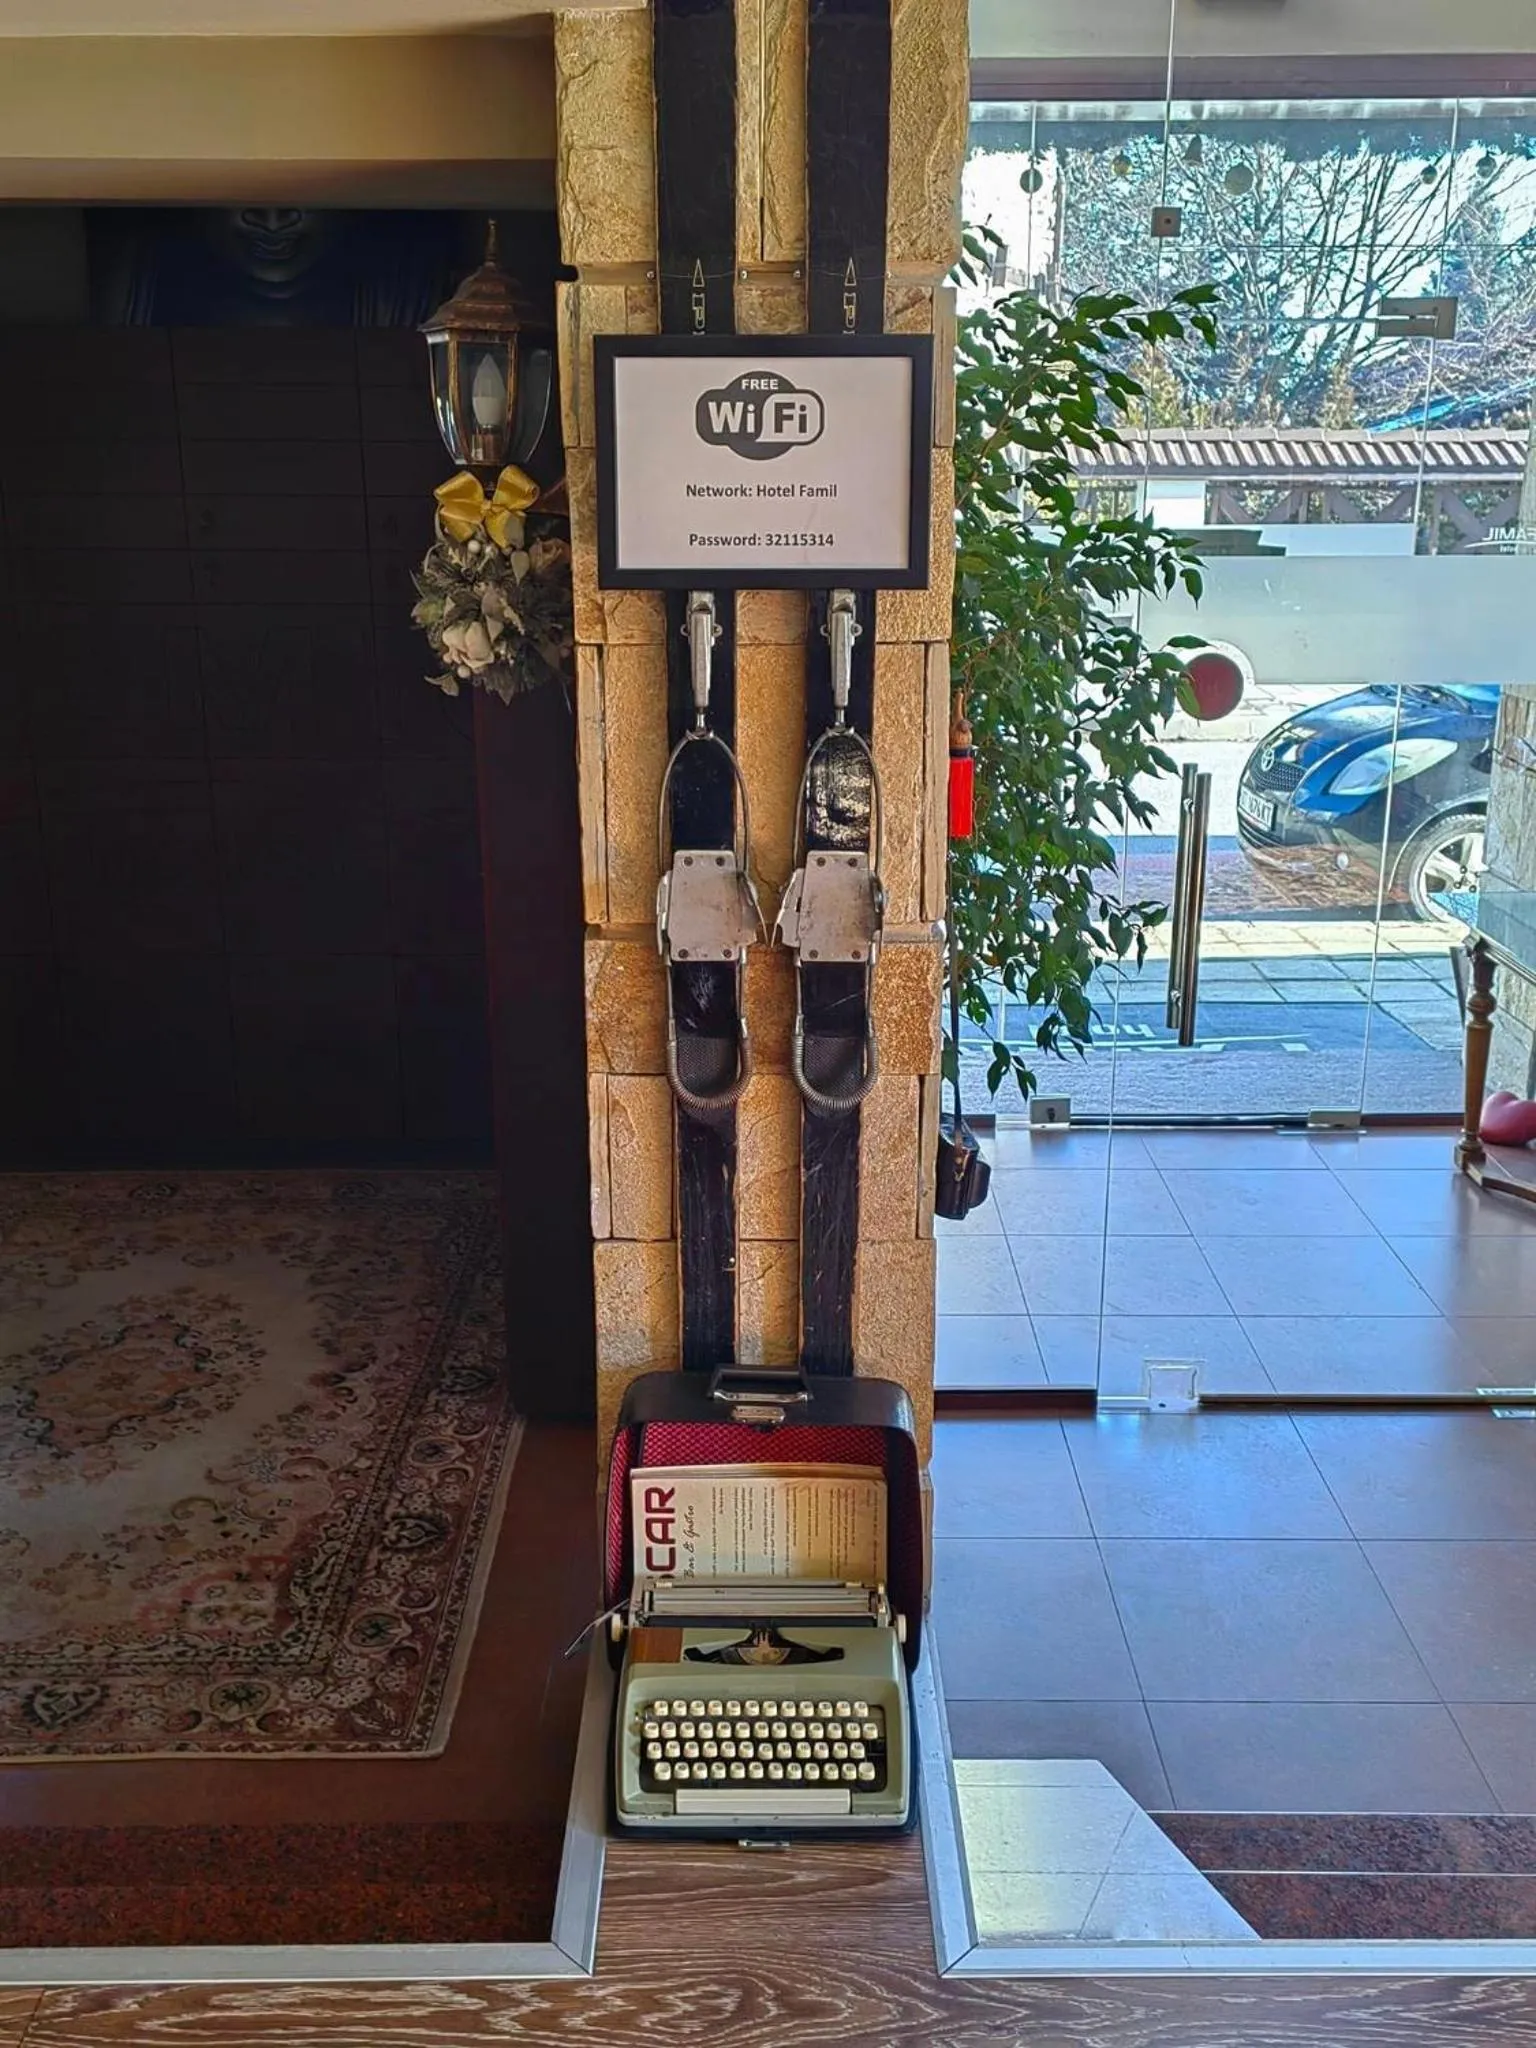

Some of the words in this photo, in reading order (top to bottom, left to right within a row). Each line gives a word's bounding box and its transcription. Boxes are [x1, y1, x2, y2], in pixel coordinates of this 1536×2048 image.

[741, 379, 779, 390] FREE
[686, 484, 752, 497] Network:
[756, 484, 795, 497] Hotel
[799, 484, 837, 497] Famil
[689, 533, 762, 547] Password:
[765, 533, 834, 547] 32115314
[683, 1505, 701, 1539] Gastro
[645, 1487, 676, 1579] CAR
